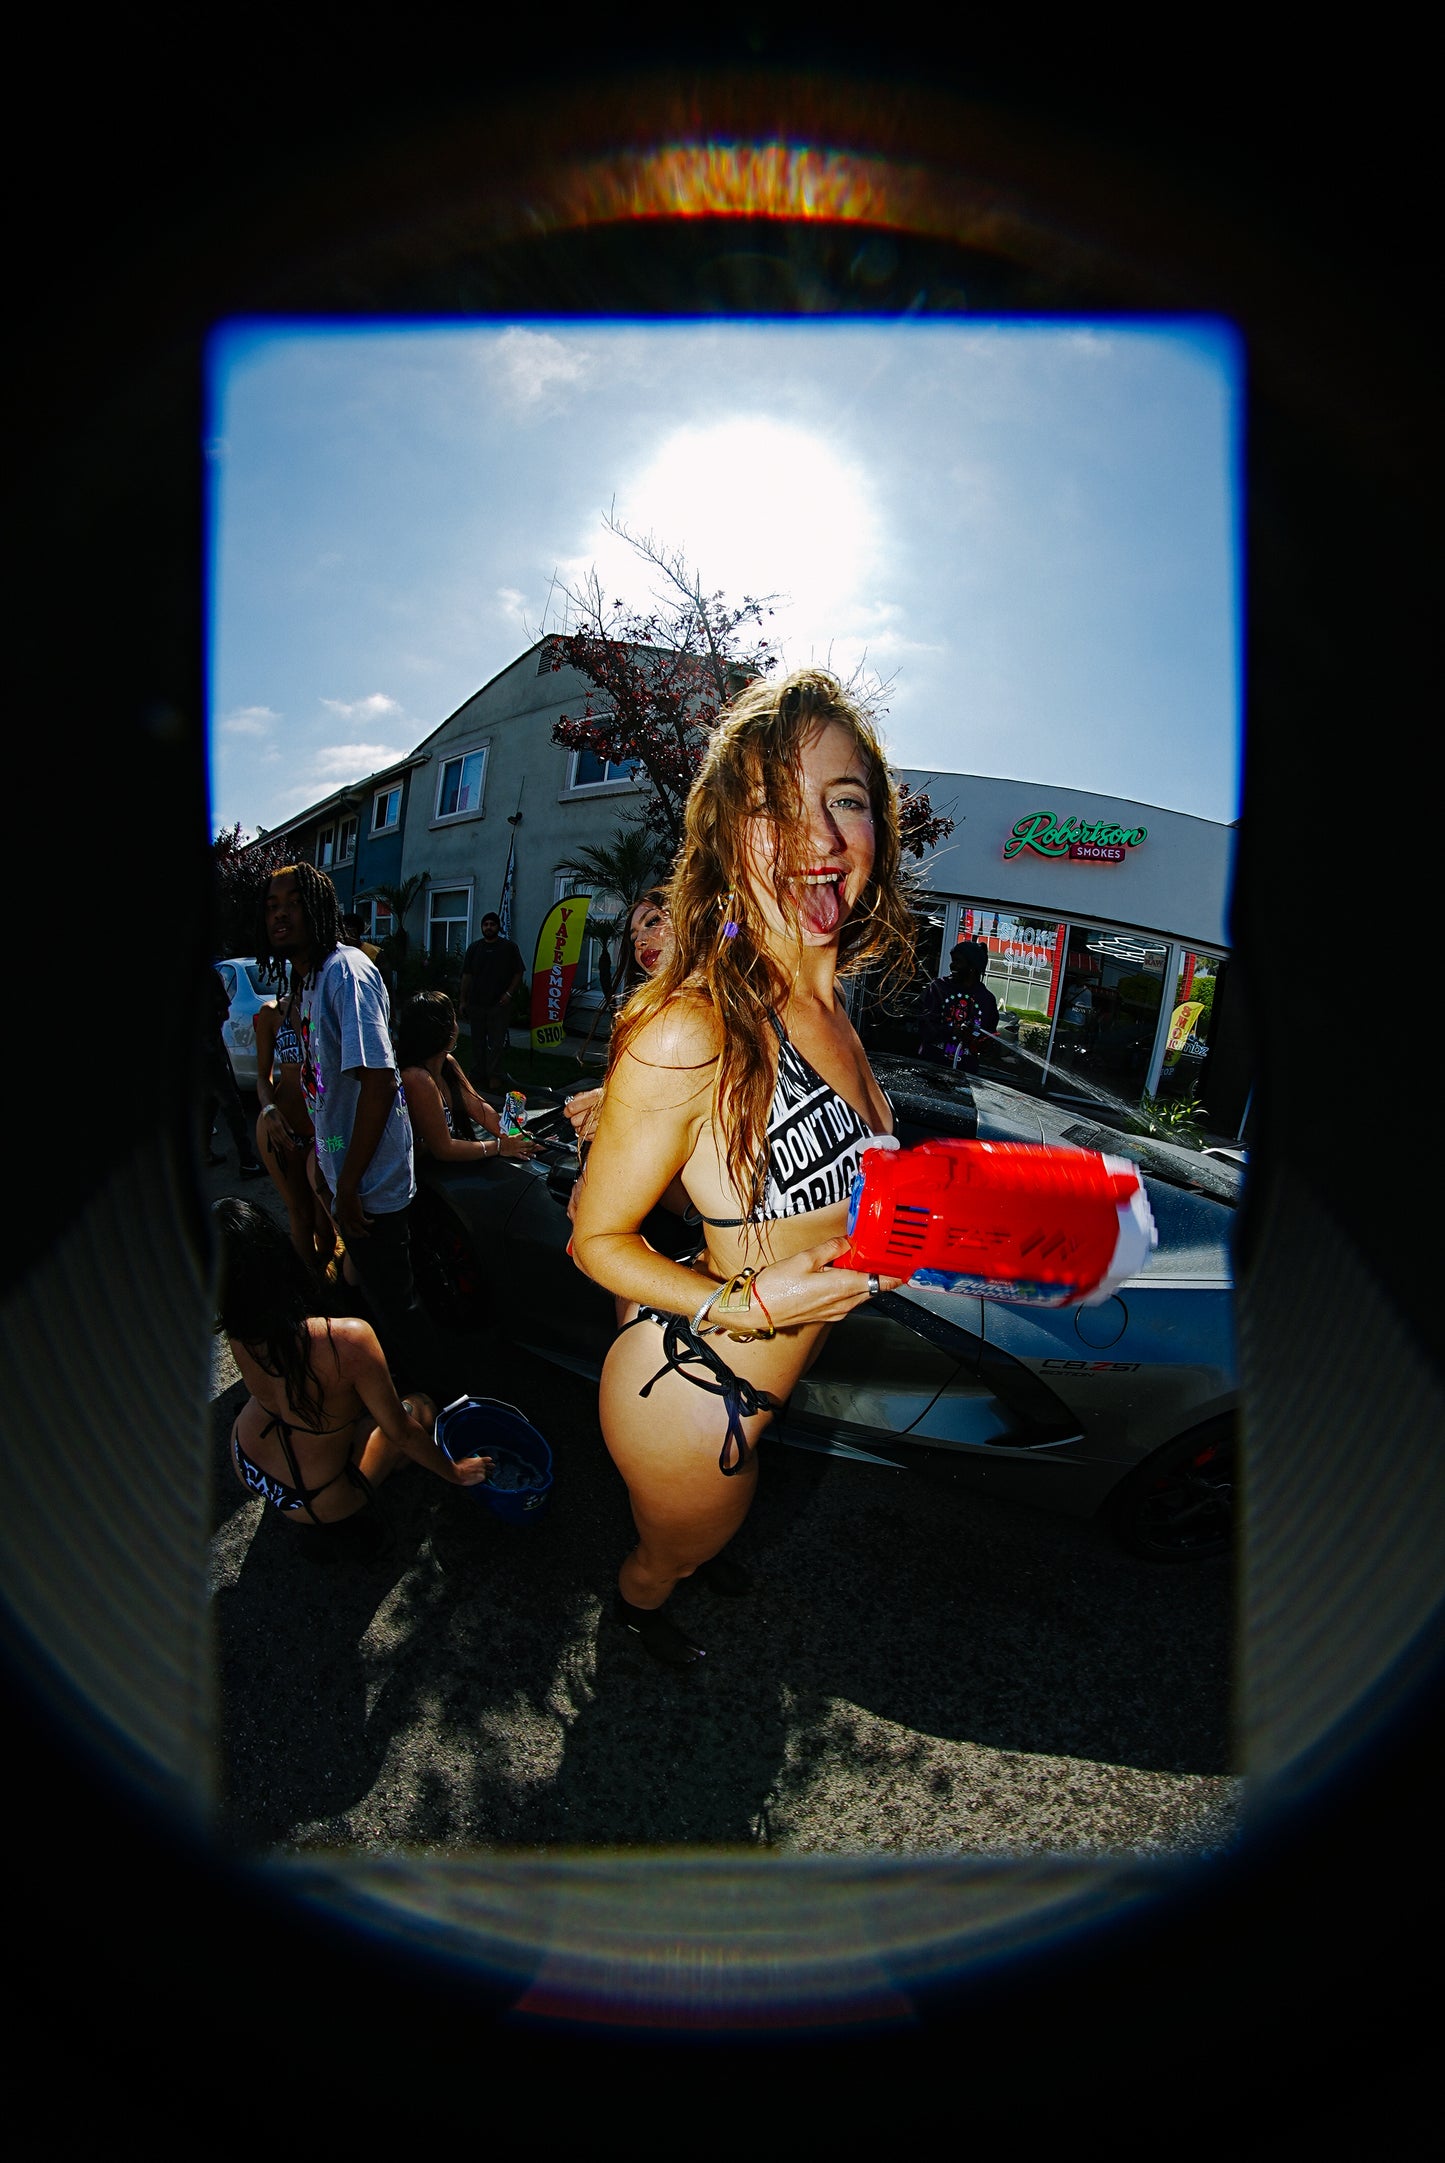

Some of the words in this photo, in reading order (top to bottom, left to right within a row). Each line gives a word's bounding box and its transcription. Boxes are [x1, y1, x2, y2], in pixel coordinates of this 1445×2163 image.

[1003, 811, 1148, 859] Robertson
[1077, 847, 1121, 859] SMOKES
[551, 907, 574, 965] VAPE
[1000, 922, 1058, 951] SMOKE
[1003, 947, 1048, 972] SHOP
[548, 965, 563, 1021] SMOKE
[771, 1107, 833, 1182] DON'T
[823, 1094, 855, 1142] DO
[790, 1153, 861, 1213] DRUG
